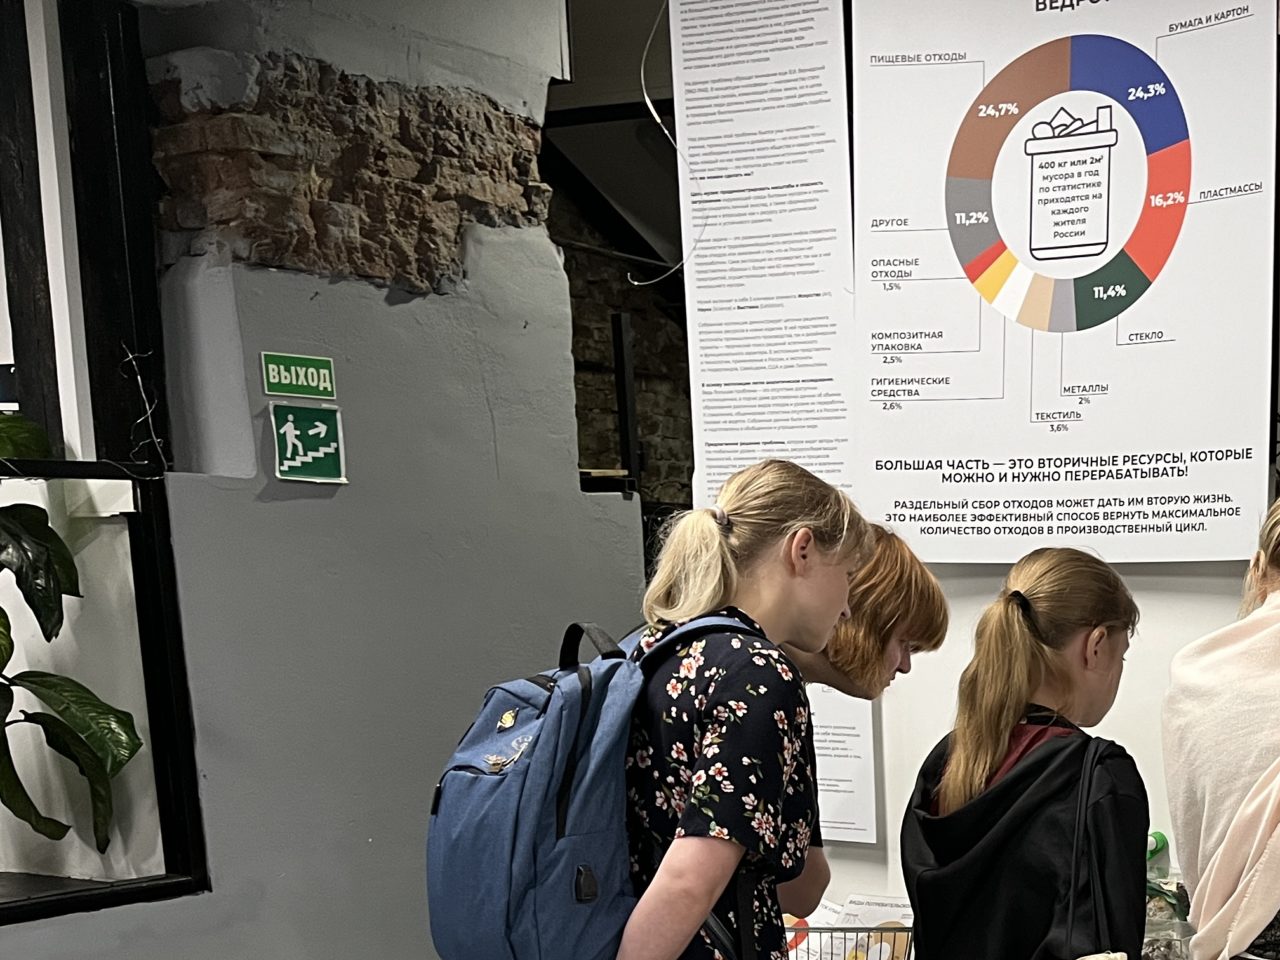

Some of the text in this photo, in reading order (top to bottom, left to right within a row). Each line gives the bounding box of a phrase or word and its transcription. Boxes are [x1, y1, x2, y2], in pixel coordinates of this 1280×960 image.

[1169, 6, 1249, 33] БУМАГА И КАРТОН
[870, 52, 966, 63] ПИЩЕВЫЕ ОТХОДЫ
[1128, 83, 1166, 100] 24,3%
[978, 103, 1019, 118] 24,7%
[1039, 161, 1055, 169] 400
[1043, 172, 1074, 182] мусора
[1052, 182, 1101, 191] статистике
[1200, 182, 1263, 199] ПЛАСТМАССЫ
[1038, 194, 1089, 206] приходятся
[1150, 191, 1185, 208] 16,2%
[1051, 206, 1089, 215] каждого
[955, 211, 988, 226] 11,2%
[871, 219, 909, 228] ДРУГОЕ
[1053, 230, 1085, 238] России
[871, 258, 920, 267] ОПАСНЫЕ
[871, 270, 912, 278] ОТХОДЫ
[883, 283, 901, 291] 1,5%
[1093, 284, 1126, 300] 11,4%
[871, 331, 943, 340] КОМПОЗИТНАЯ
[1128, 331, 1164, 341] СТЕКЛО
[871, 343, 922, 351] УПАКОВКА
[883, 356, 902, 364] 2,5%
[268, 364, 332, 392] ВЫХОД
[871, 377, 950, 386] ГИГИЕНИЧЕСКИЕ
[871, 389, 920, 397] СРЕДСТВА
[1063, 384, 1109, 393] МЕТАЛЛЫ
[1078, 397, 1090, 405] 2%
[882, 402, 902, 410] 2,6%
[1035, 411, 1082, 420] ТЕКСТИЛЬ
[1050, 424, 1069, 432] 3,6%
[875, 447, 1252, 470] БОЛЬШАЯ ЧАСТЬ ЭТО ВТОРИЧНЫЕ РЕСУРСЫ, КОТОРЫЕ
[941, 466, 1188, 483] МОЖНО И НУЖНО ПЕРЕРАБАТЫВАТЬ!
[894, 493, 1233, 510] РАЗДЕЛЬНЫЙ СБОР ОТХОДОВ МОЖЕТ ДАТЬ ИМ ВТОРУЮ ЖИЗНЬ.
[885, 506, 1240, 522] ЭТО НАИБОЛЕЕ ЭФФЕКТИВНЫЙ СПОСОБ ВЕРНУТЬ МАКСИМАЛЬНОЕ
[920, 521, 1207, 536] КОЛИЧЕСТВО ОТХОДОВ В ПРОИЗВОДСТВЕННЫЙ ЦИКЛ.
